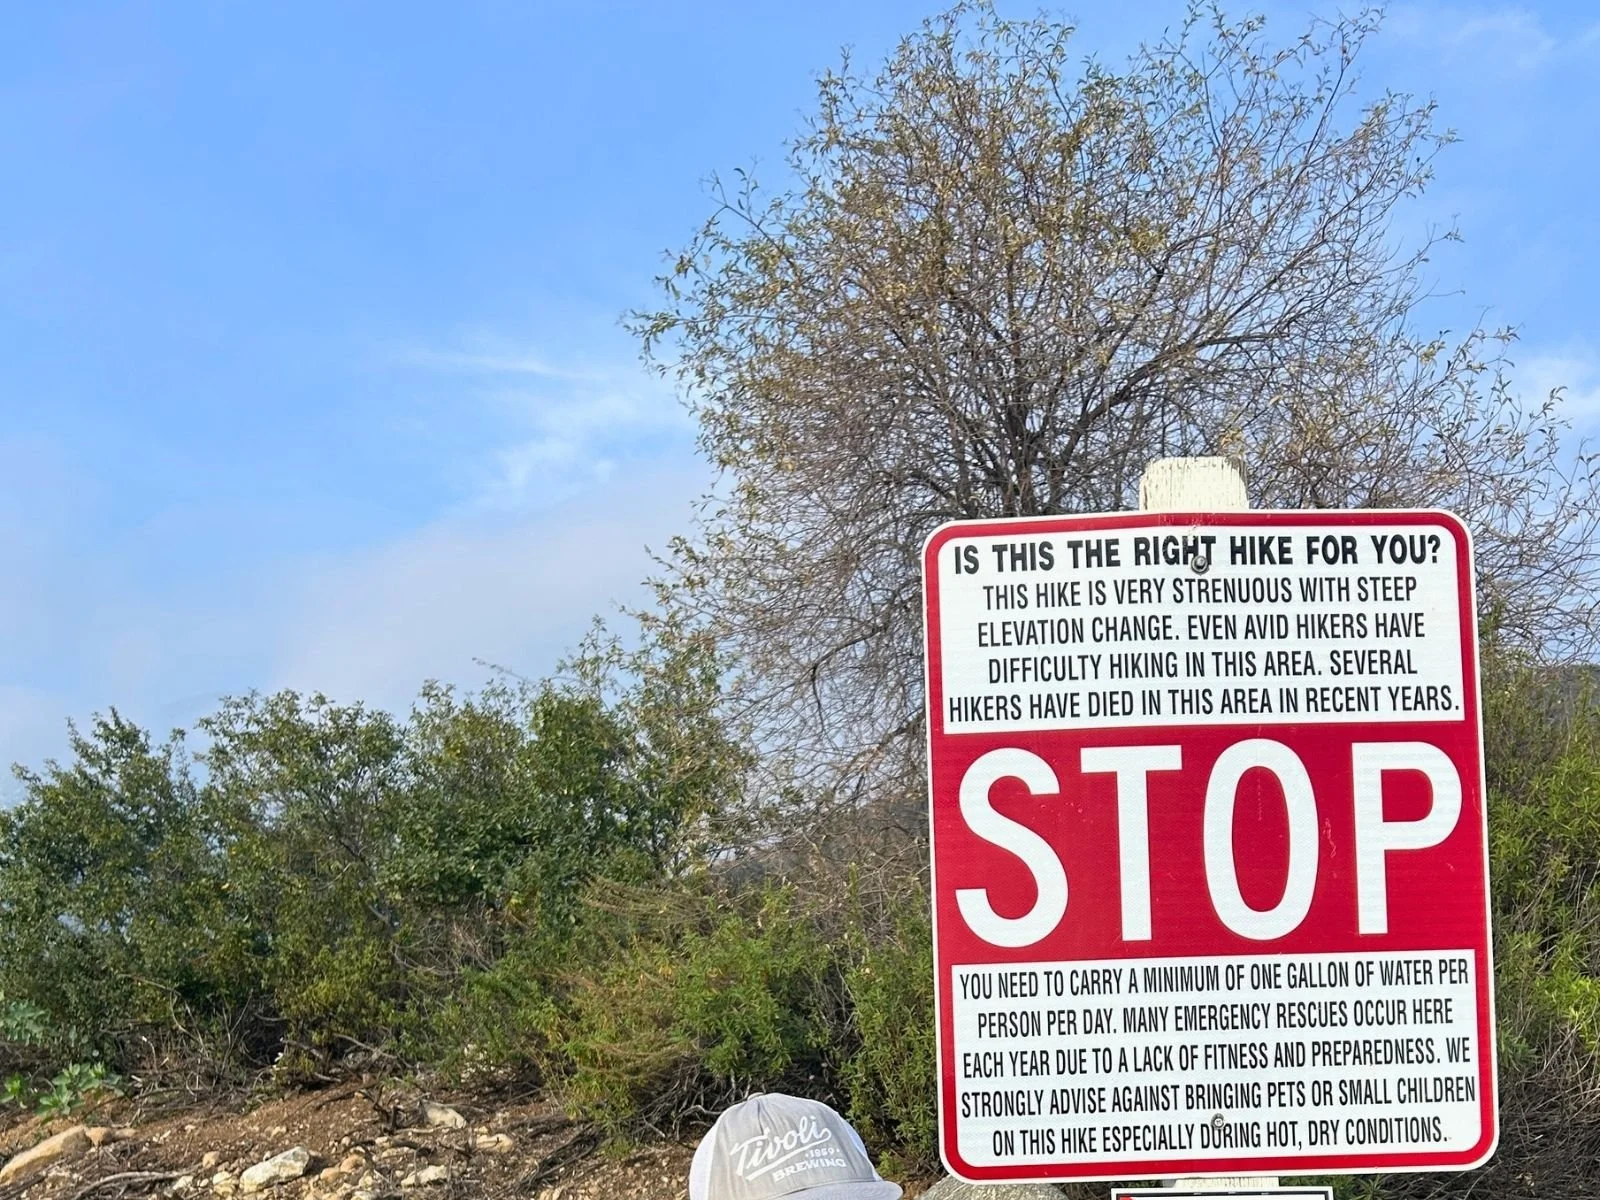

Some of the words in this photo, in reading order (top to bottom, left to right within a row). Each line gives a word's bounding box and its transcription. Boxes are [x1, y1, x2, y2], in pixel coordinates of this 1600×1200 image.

[954, 544, 980, 575] IS
[991, 541, 1055, 573] THIS
[1067, 538, 1121, 569] THE
[1133, 535, 1217, 567] RIGHT
[1229, 535, 1294, 566] HIKE
[1306, 534, 1359, 566] FOR
[1370, 534, 1441, 565] YOU?
[982, 583, 1029, 611] THIS
[1036, 581, 1081, 608] HIKE
[1088, 579, 1107, 606] IS
[1113, 577, 1166, 605] VERY
[1172, 576, 1293, 604] STRENUOUS
[1298, 576, 1350, 603] WITH
[1357, 576, 1417, 603] STEEP
[978, 617, 1084, 648] ELEVATION
[1091, 614, 1180, 643] CHANGE.
[1187, 614, 1237, 640] EVEN
[1244, 614, 1289, 640] AVID
[1296, 612, 1368, 640] HIKERS
[1375, 612, 1425, 638] HAVE
[988, 654, 1102, 684] DIFFICULTY
[1109, 651, 1178, 680] HIKING
[1185, 651, 1205, 678] IN
[1211, 650, 1257, 677] THIS
[1263, 650, 1322, 677] AREA.
[1329, 649, 1418, 676] SEVERAL
[949, 694, 1022, 723] HIKERS
[1029, 692, 1081, 720] HAVE
[1088, 690, 1134, 718] DIED
[1141, 689, 1161, 716] IN
[1167, 688, 1214, 715] THIS
[1220, 688, 1273, 714] AREA
[1279, 687, 1299, 713] IN
[1305, 686, 1382, 713] RECENT
[1387, 684, 1459, 712] YEARS.
[955, 738, 1463, 949] STOP
[959, 973, 992, 1000] YOU
[998, 971, 1039, 999] NEED
[1043, 970, 1064, 997] TO
[1069, 968, 1123, 996] CARRY
[1128, 967, 1139, 994] A
[1143, 965, 1220, 993] MINIMUM
[1225, 964, 1245, 991] OF
[1250, 963, 1282, 991] ONE
[1287, 961, 1349, 989] GALLON
[1354, 960, 1375, 988] OF
[1379, 959, 1434, 986] WATER
[1438, 958, 1469, 985] PER
[977, 1010, 1042, 1039] PERSON
[1046, 1009, 1078, 1036] PER
[1082, 1007, 1117, 1035] DAY.
[1123, 1006, 1169, 1034] MANY
[1174, 1002, 1271, 1032] EMERGENCY
[1276, 1000, 1348, 1029] RESCUES
[1353, 999, 1408, 1027] OCCUR
[1412, 998, 1453, 1025] HERE
[963, 1051, 1004, 1079] EACH
[1008, 1049, 1051, 1077] YEAR
[1055, 1048, 1088, 1076] DUE
[1091, 1047, 1113, 1074] TO
[1118, 1047, 1129, 1073] A
[1133, 1045, 1174, 1073] LACK
[1178, 1044, 1199, 1072] OF
[1204, 1041, 1269, 1070] FITNESS
[1273, 1041, 1306, 1068] AND
[1311, 1037, 1441, 1067] PREPAREDNESS.
[1445, 1037, 1471, 1063] WE
[961, 1089, 1044, 1119] STRONGLY
[1049, 1087, 1107, 1115] ADVISE
[1111, 1084, 1180, 1113] AGAINST
[1185, 1081, 1262, 1110] BRINGING
[1267, 1080, 1306, 1108] PETS
[1311, 1079, 1334, 1107] OR
[1338, 1078, 1393, 1106] SMALL
[1397, 1076, 1476, 1105] CHILDREN
[730, 1116, 832, 1178] Tivoli
[992, 1130, 1015, 1157] ON
[1019, 1128, 1056, 1156] THIS
[1061, 1127, 1098, 1154] HIKE
[1102, 1123, 1195, 1153] ESPECIALLY
[1200, 1121, 1261, 1149] DURING
[1266, 1120, 1302, 1151] HOT,
[1308, 1119, 1340, 1146] DRY
[1345, 1116, 1448, 1146] CONDITIONS.
[772, 1158, 847, 1182] BREWING
